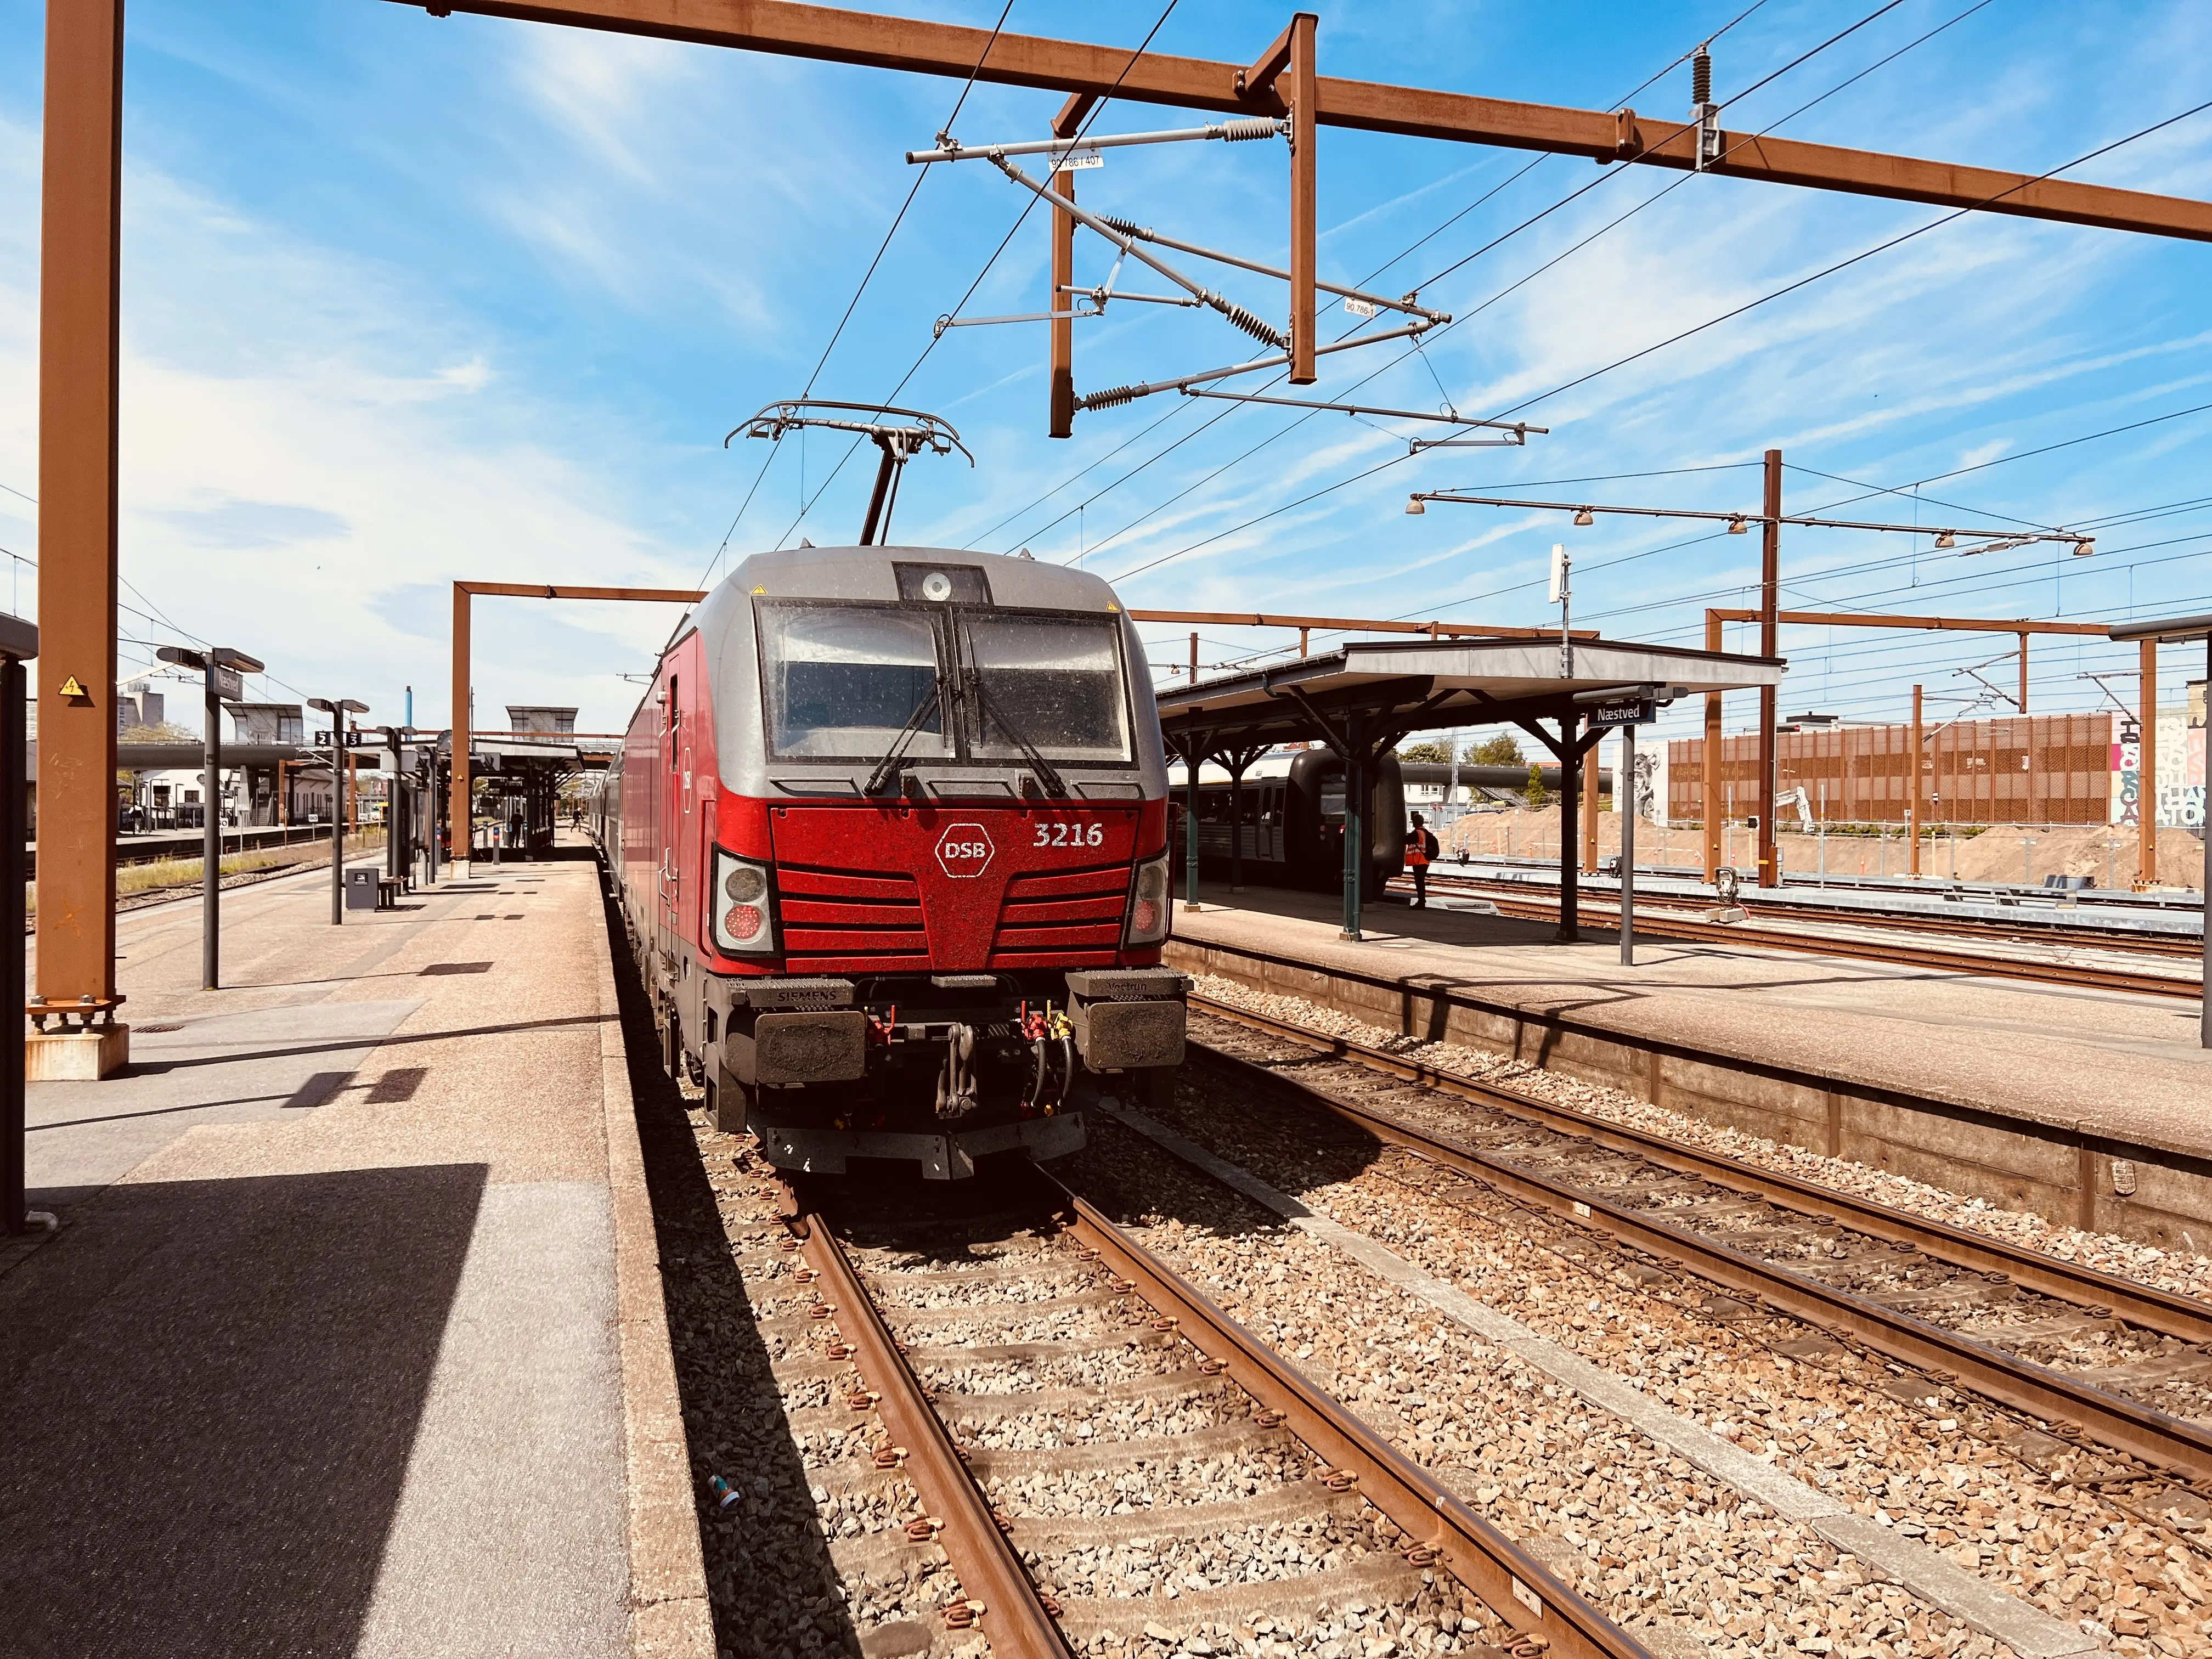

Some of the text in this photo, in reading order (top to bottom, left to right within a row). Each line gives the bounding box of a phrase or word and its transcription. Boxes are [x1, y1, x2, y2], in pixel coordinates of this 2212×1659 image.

[1086, 156, 1099, 165] 407
[219, 670, 239, 692] Næstved
[1598, 704, 1640, 721] Næstved
[319, 735, 326, 744] 2
[350, 736, 357, 745] 3
[1033, 823, 1103, 847] 3216
[945, 843, 985, 858] DSB
[778, 991, 837, 1002] SIEMENS
